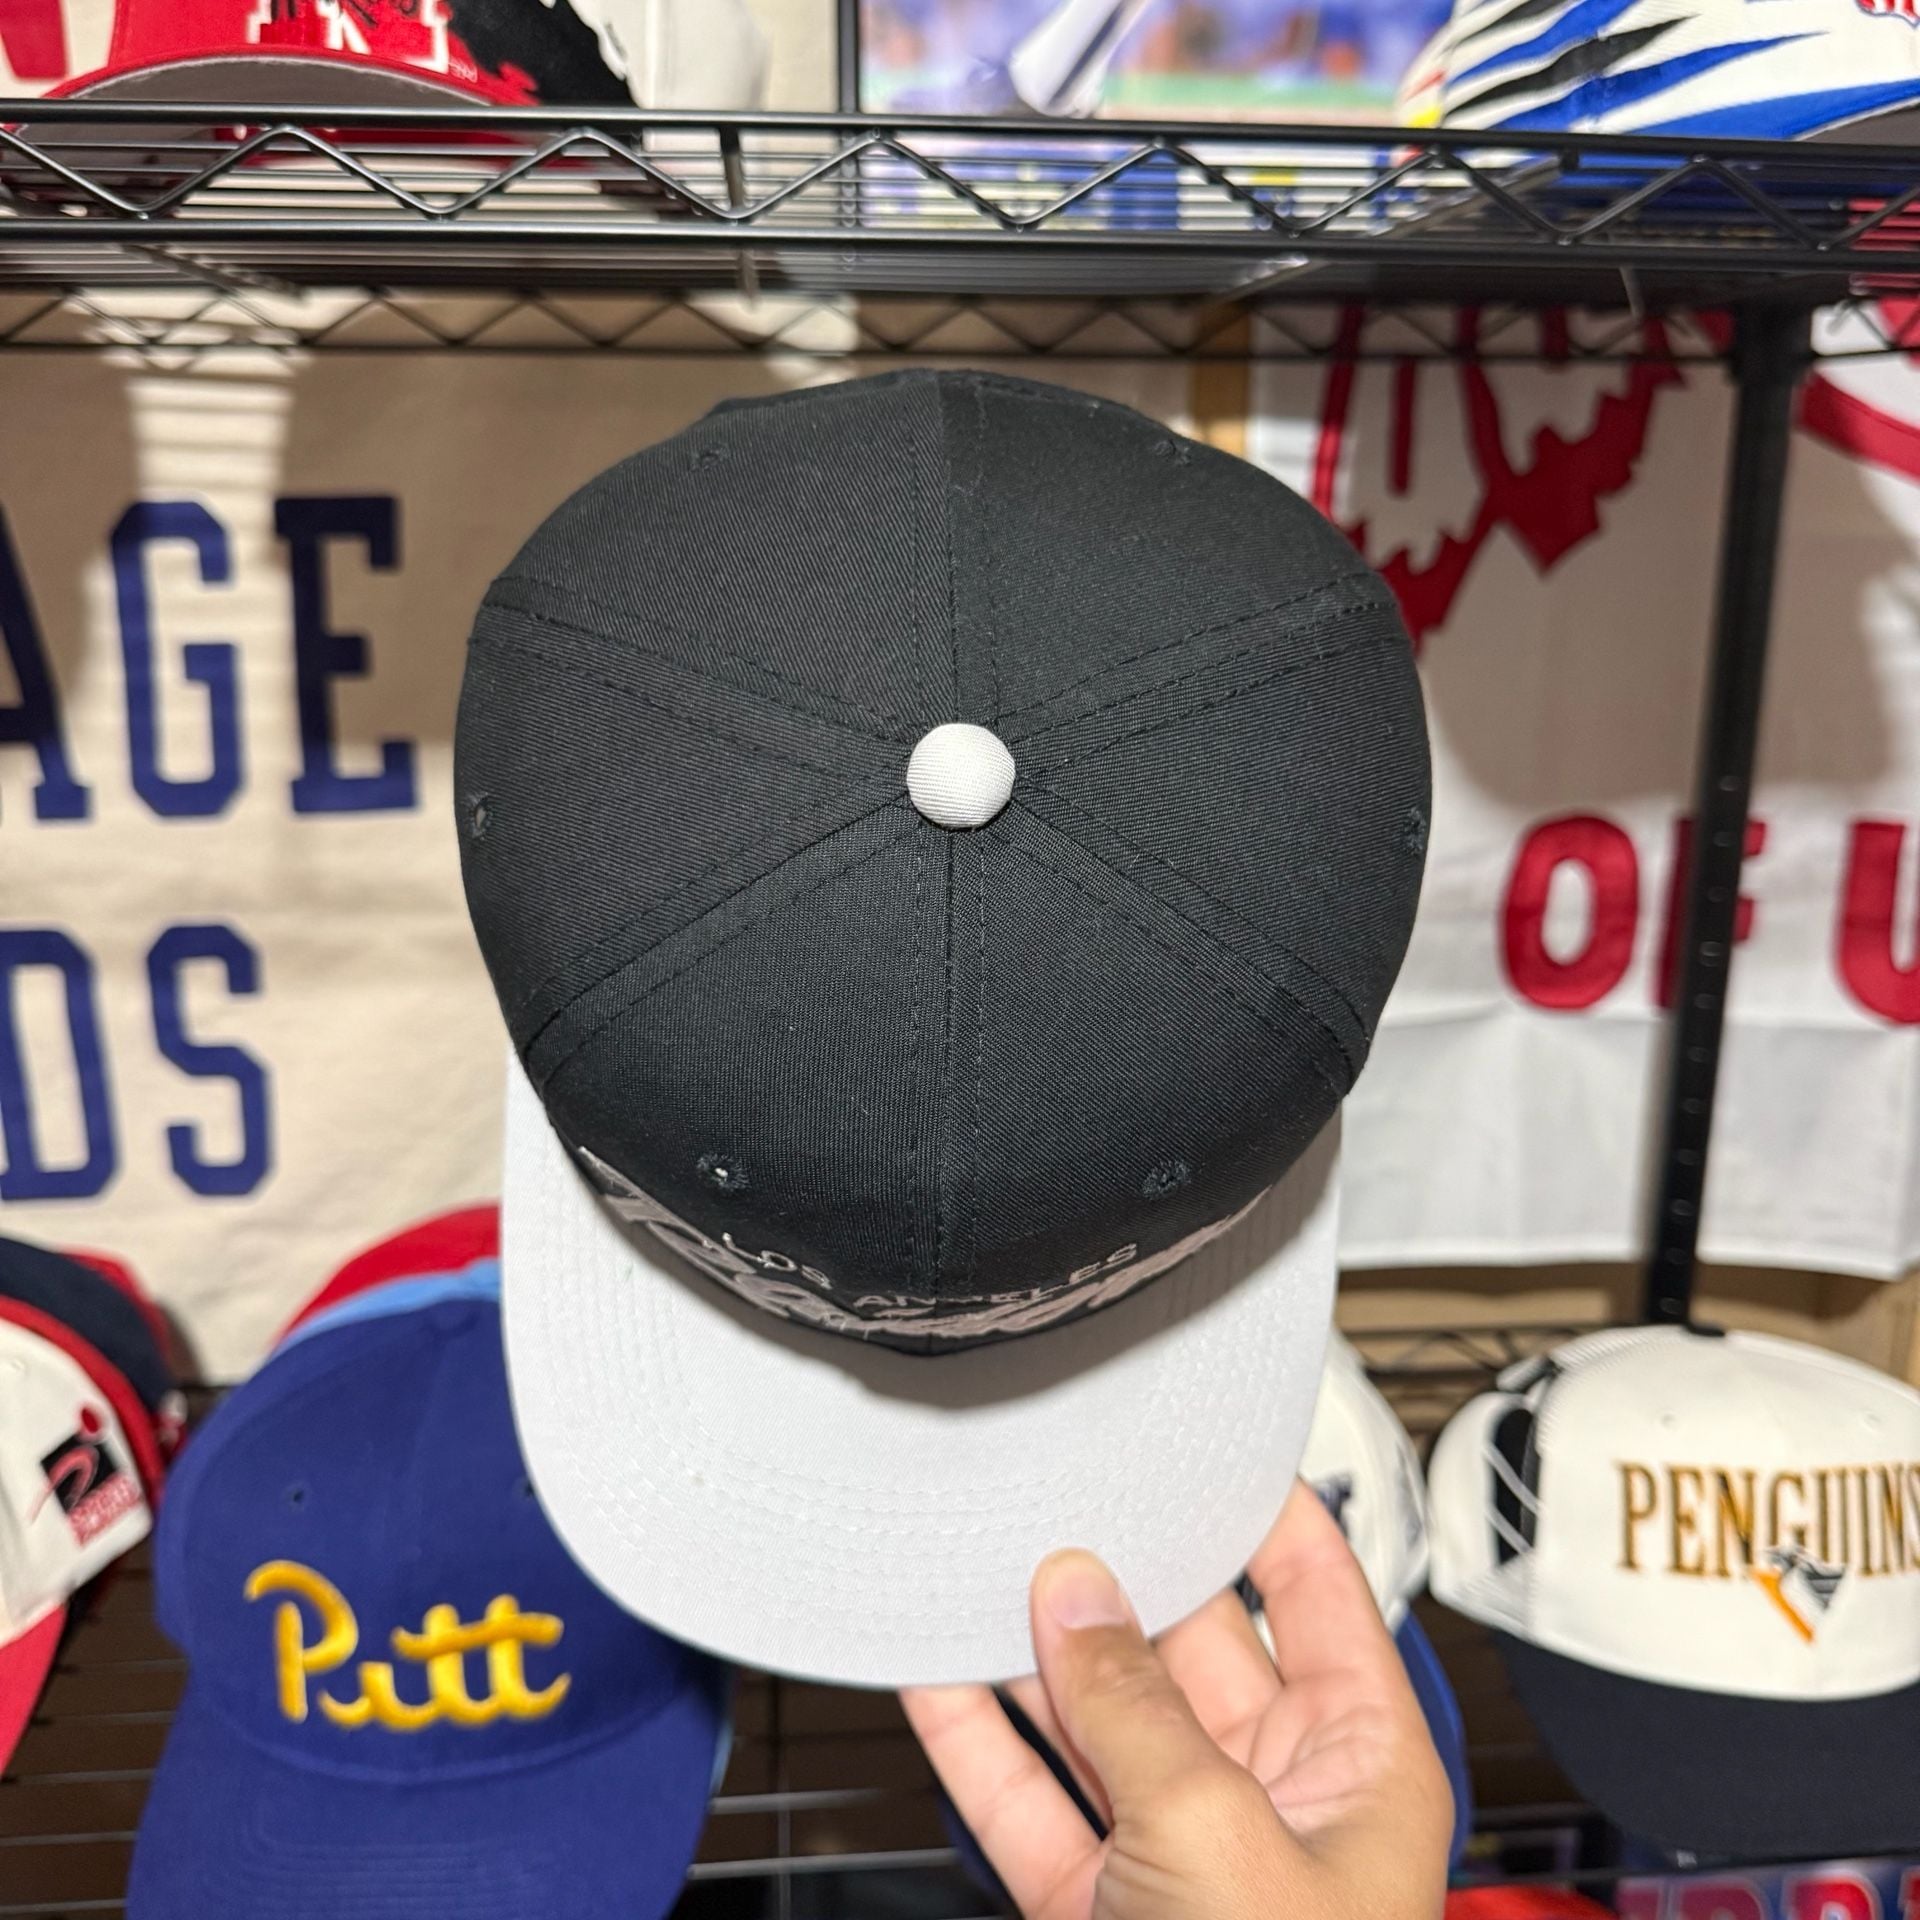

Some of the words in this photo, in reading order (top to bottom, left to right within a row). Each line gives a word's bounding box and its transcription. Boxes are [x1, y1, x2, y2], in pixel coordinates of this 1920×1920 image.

[721, 1231, 834, 1290] LOS
[853, 1242, 1138, 1308] ANELES
[243, 1559, 573, 1733] Pitt
